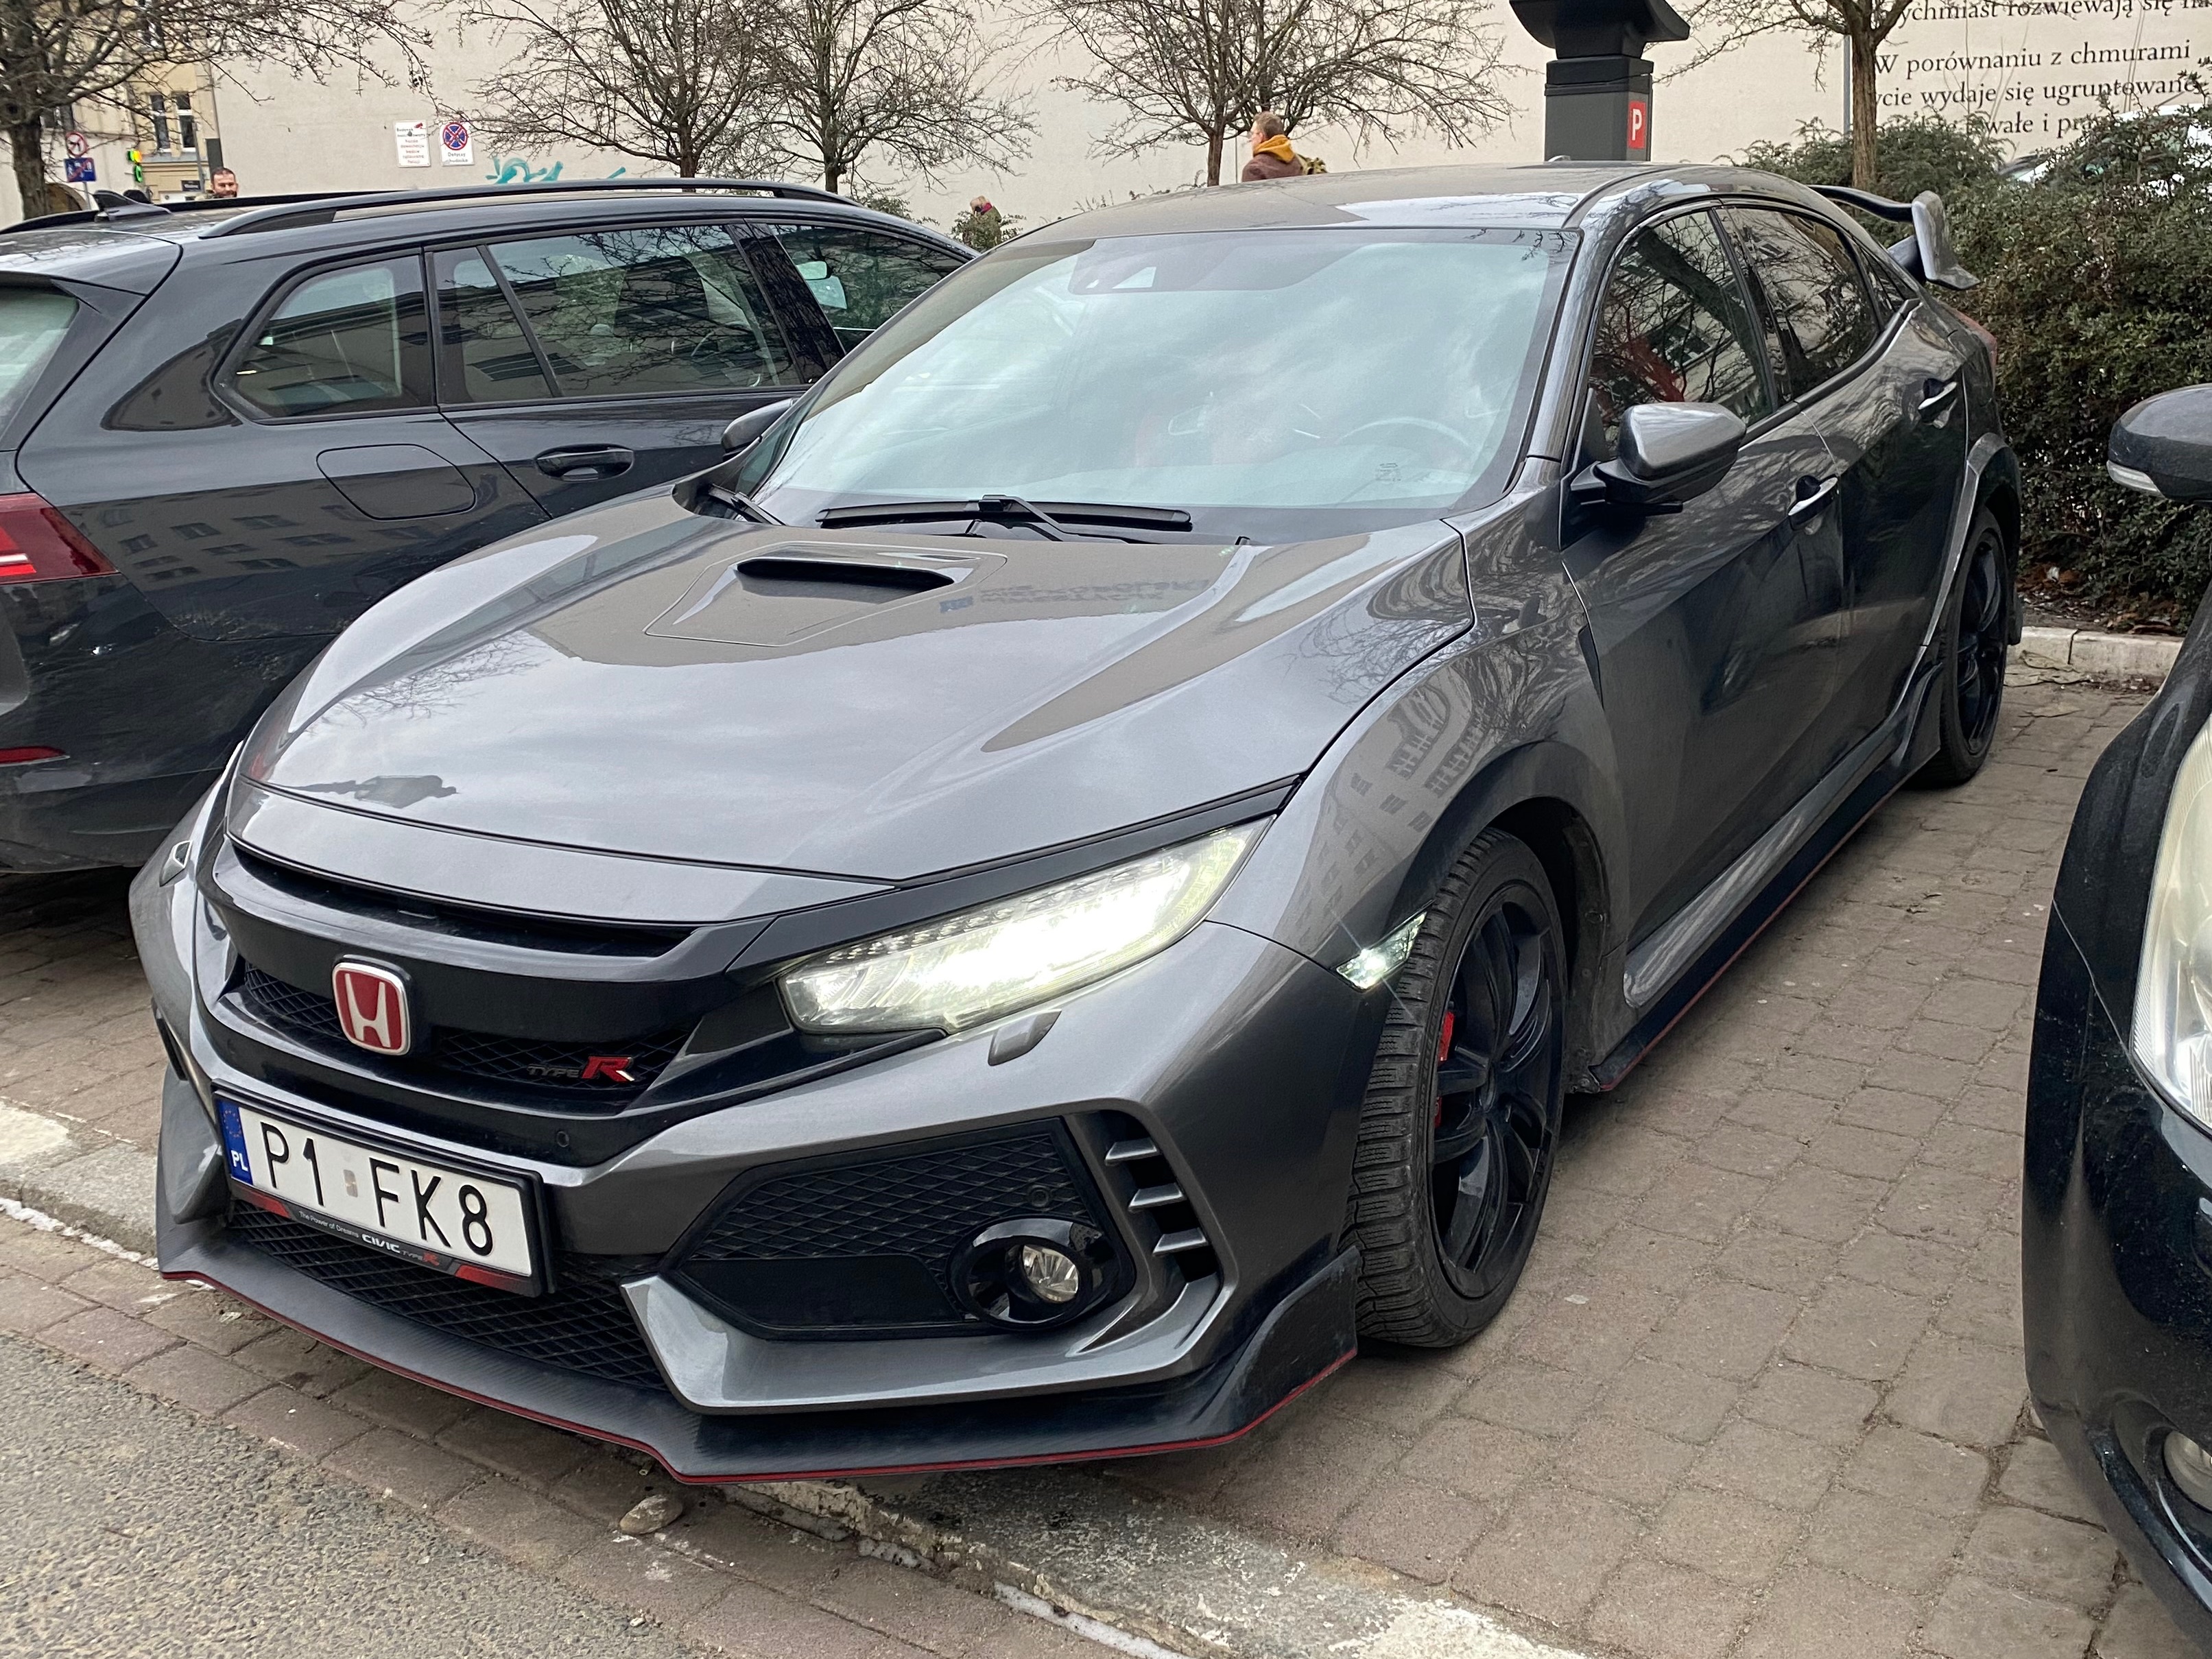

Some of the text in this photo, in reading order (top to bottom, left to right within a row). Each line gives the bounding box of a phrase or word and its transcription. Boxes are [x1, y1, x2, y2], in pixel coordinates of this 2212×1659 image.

[1906, 47, 2041, 80] porównaniu
[2050, 51, 2062, 65] z
[2071, 39, 2191, 64] chmurami
[1920, 81, 1997, 111] wydaje
[2005, 81, 2034, 106] się
[1632, 108, 1642, 141] P
[2043, 113, 2049, 132] i
[582, 1055, 635, 1082] R
[231, 1150, 248, 1171] PL
[260, 1121, 494, 1256] P1 FK8
[299, 1210, 440, 1266] The Power of Dreams CIVIC TYPE R
